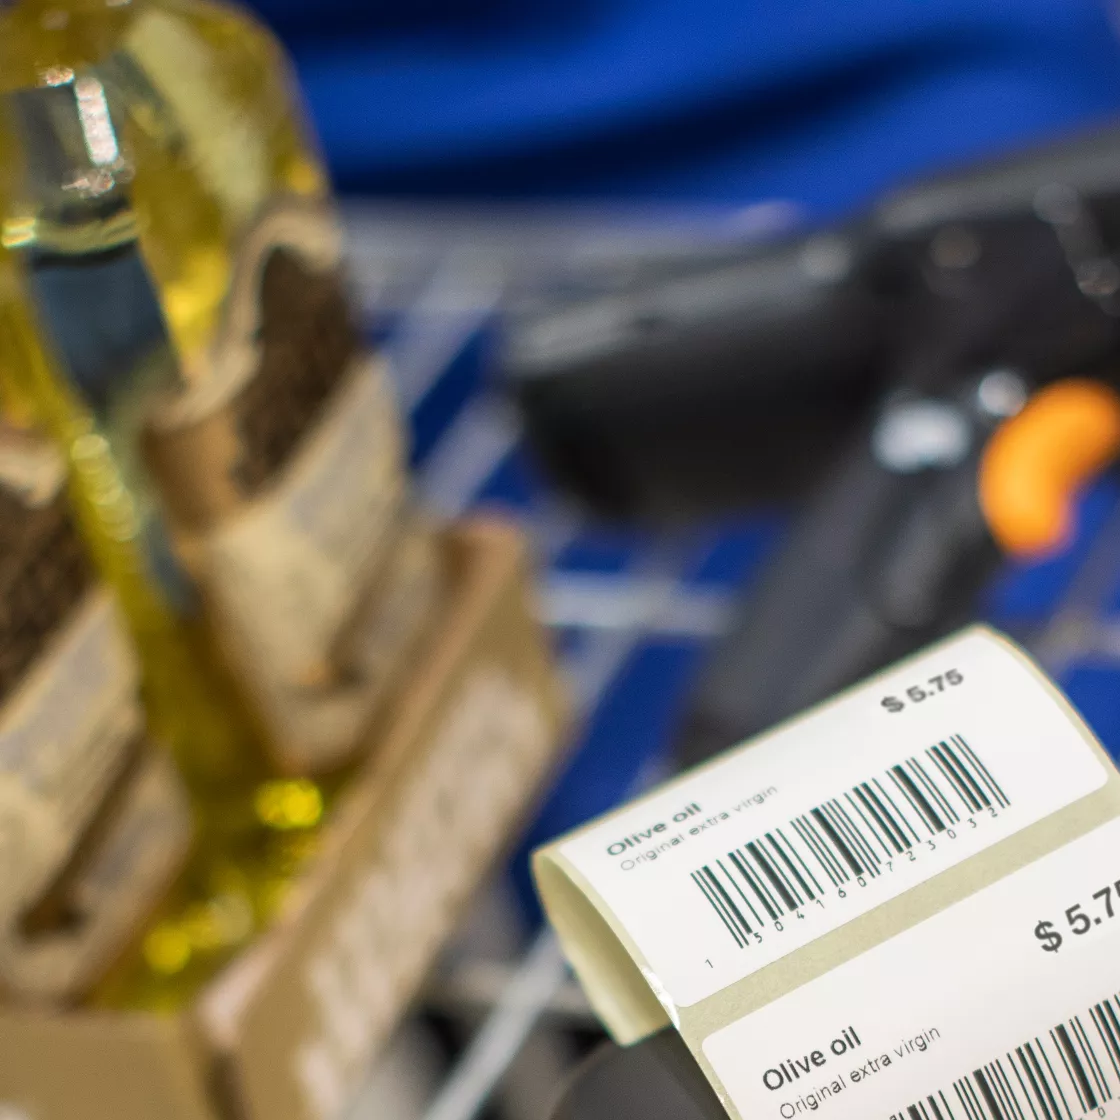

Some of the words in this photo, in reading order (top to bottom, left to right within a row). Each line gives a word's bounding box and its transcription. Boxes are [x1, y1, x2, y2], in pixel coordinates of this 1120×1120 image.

[880, 696, 905, 713] $
[906, 668, 964, 703] 5.75
[606, 822, 668, 856] Olive
[672, 802, 702, 823] oil
[620, 834, 685, 871] Original
[688, 811, 731, 836] extra
[732, 785, 778, 813] virgin
[1034, 920, 1063, 953] $
[762, 1050, 827, 1091] Olive
[830, 1025, 862, 1056] oil
[779, 1074, 847, 1119] Original
[849, 1054, 892, 1083] extra
[893, 1026, 941, 1058] virgin
